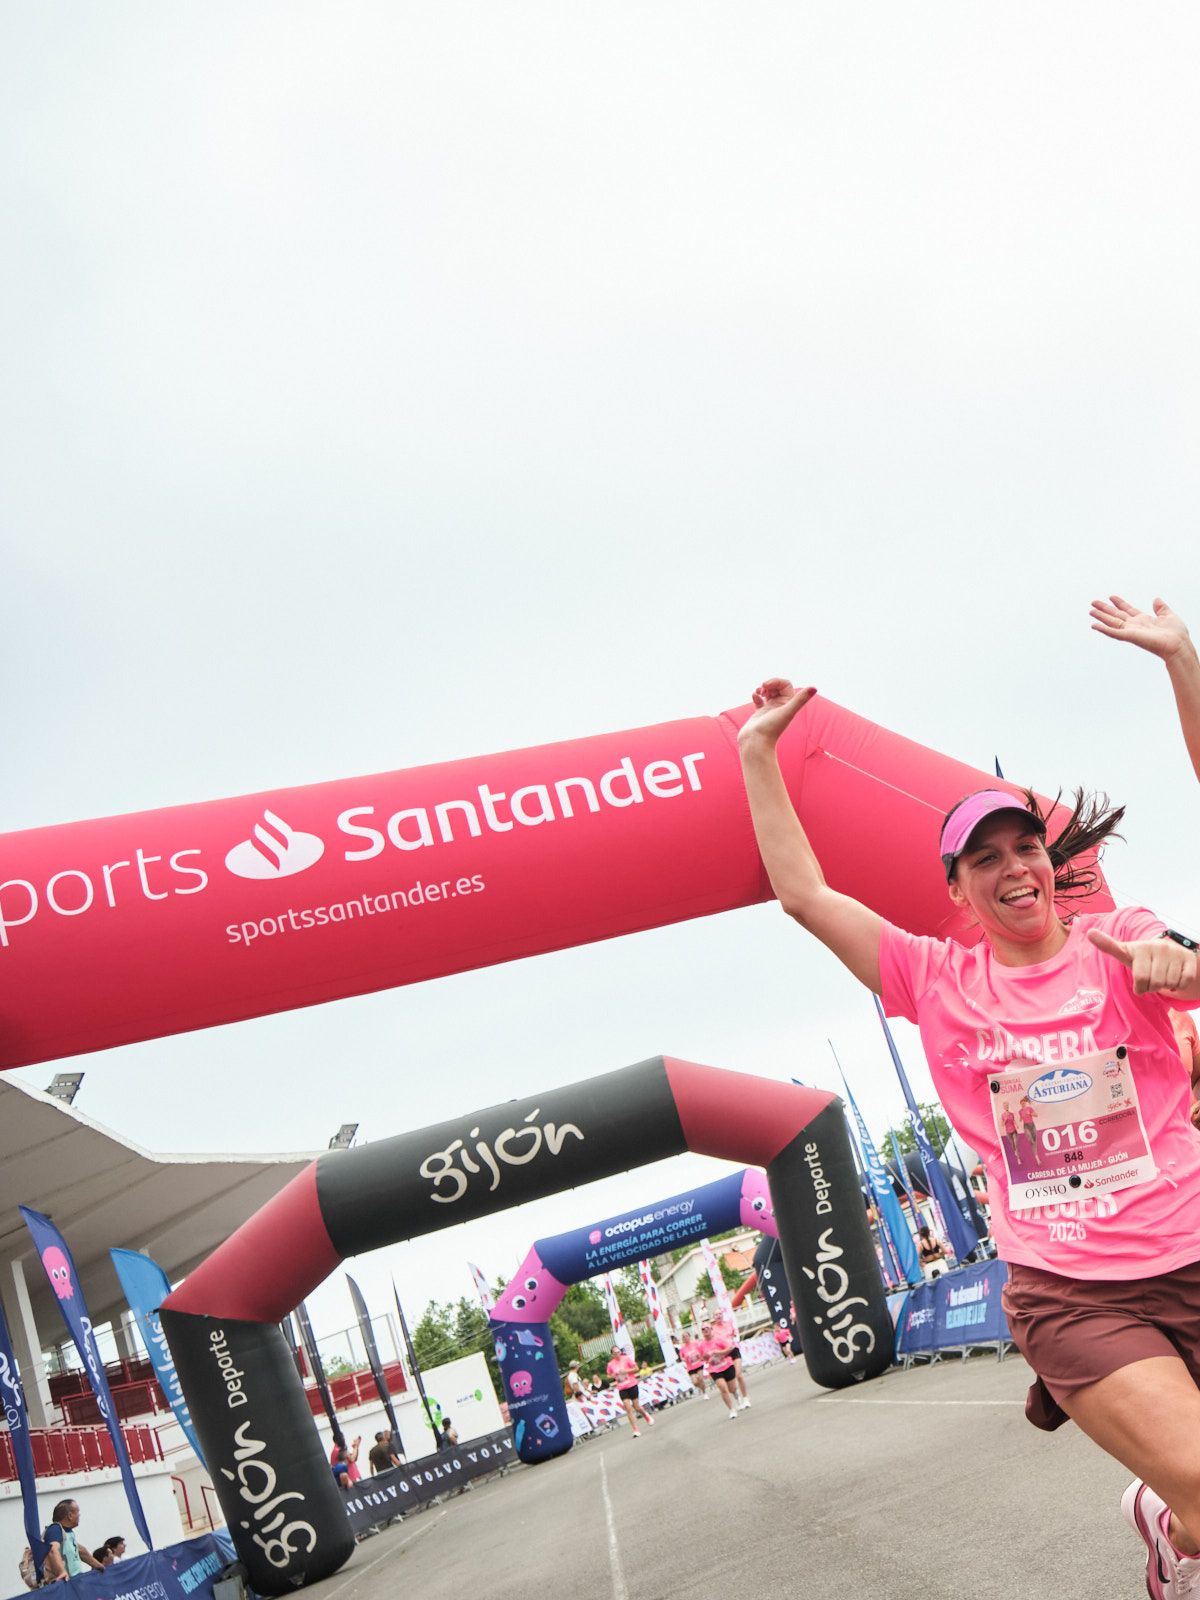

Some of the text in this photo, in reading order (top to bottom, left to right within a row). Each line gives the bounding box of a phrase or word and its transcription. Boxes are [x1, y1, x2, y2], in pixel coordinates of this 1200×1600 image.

[0, 752, 706, 947] ports Santander
[226, 874, 486, 945] sportssantander.es
[1033, 1080, 1089, 1099] ASTURIANA
[419, 1108, 585, 1203] gijón
[1042, 1120, 1098, 1151] 016
[1064, 1150, 1084, 1163] 848
[803, 1141, 832, 1215] Deporte
[1025, 1169, 1139, 1199] OYSHO Santander
[1027, 1151, 1129, 1180] CARRERA DE LA MUJER GIJÓN
[586, 1213, 703, 1260] LA ENERGÍA PARA CORRER
[605, 1199, 695, 1237] octopus energy
[1048, 1221, 1087, 1242] 2026
[597, 1256, 609, 1267] LA
[610, 1239, 661, 1262] VELOCIDAD
[663, 1233, 675, 1244] DE
[676, 1228, 688, 1239] LA
[690, 1221, 708, 1234] LUZ
[763, 1268, 788, 1328] OLVO
[802, 1228, 875, 1364] gijón
[210, 1328, 318, 1568] gijón Deporte
[364, 1480, 410, 1507] VOLVO
[412, 1458, 462, 1486] VOLVO
[467, 1437, 513, 1463] VOLV
